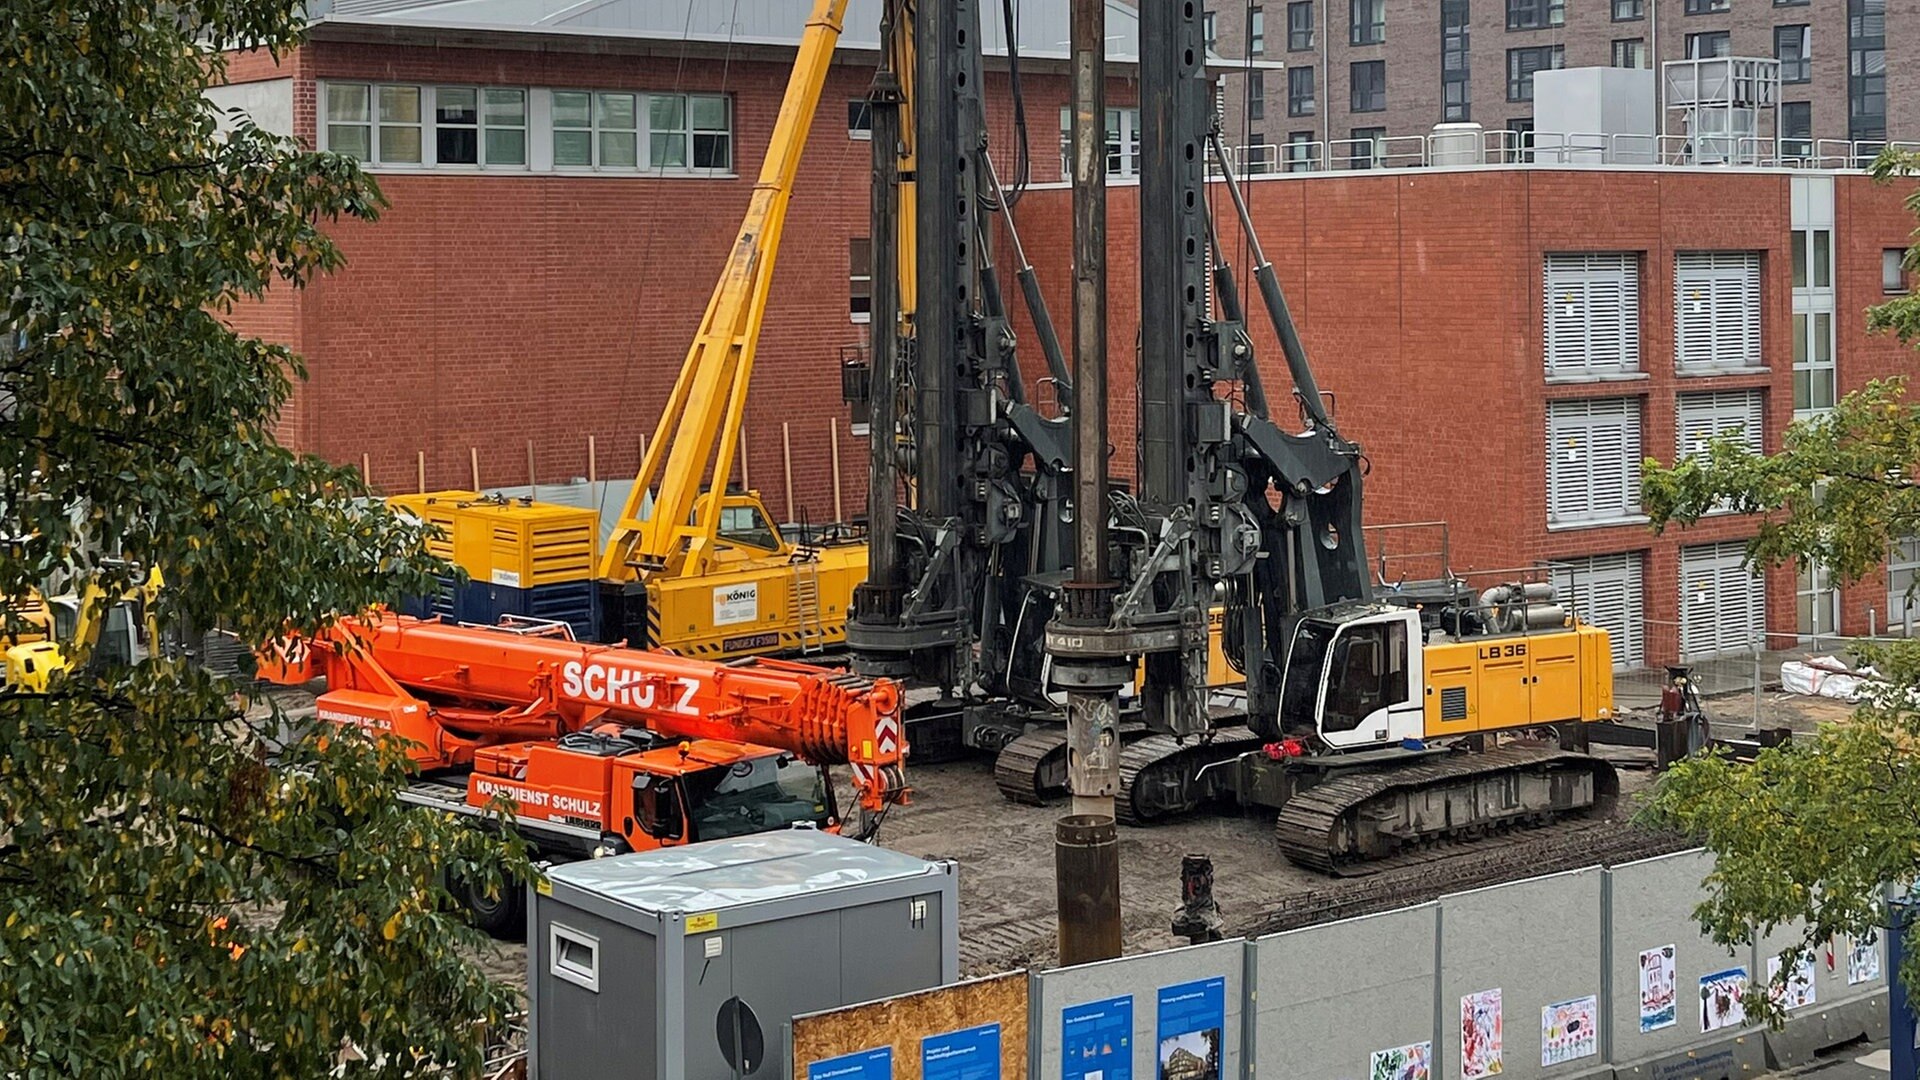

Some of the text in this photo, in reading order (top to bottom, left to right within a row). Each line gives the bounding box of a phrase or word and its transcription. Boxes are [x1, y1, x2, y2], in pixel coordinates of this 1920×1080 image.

[726, 590, 756, 601] KÖNIG
[1479, 643, 1526, 660] LB 36
[562, 661, 700, 716] SCHUZ
[552, 794, 601, 816] SCHULZ
